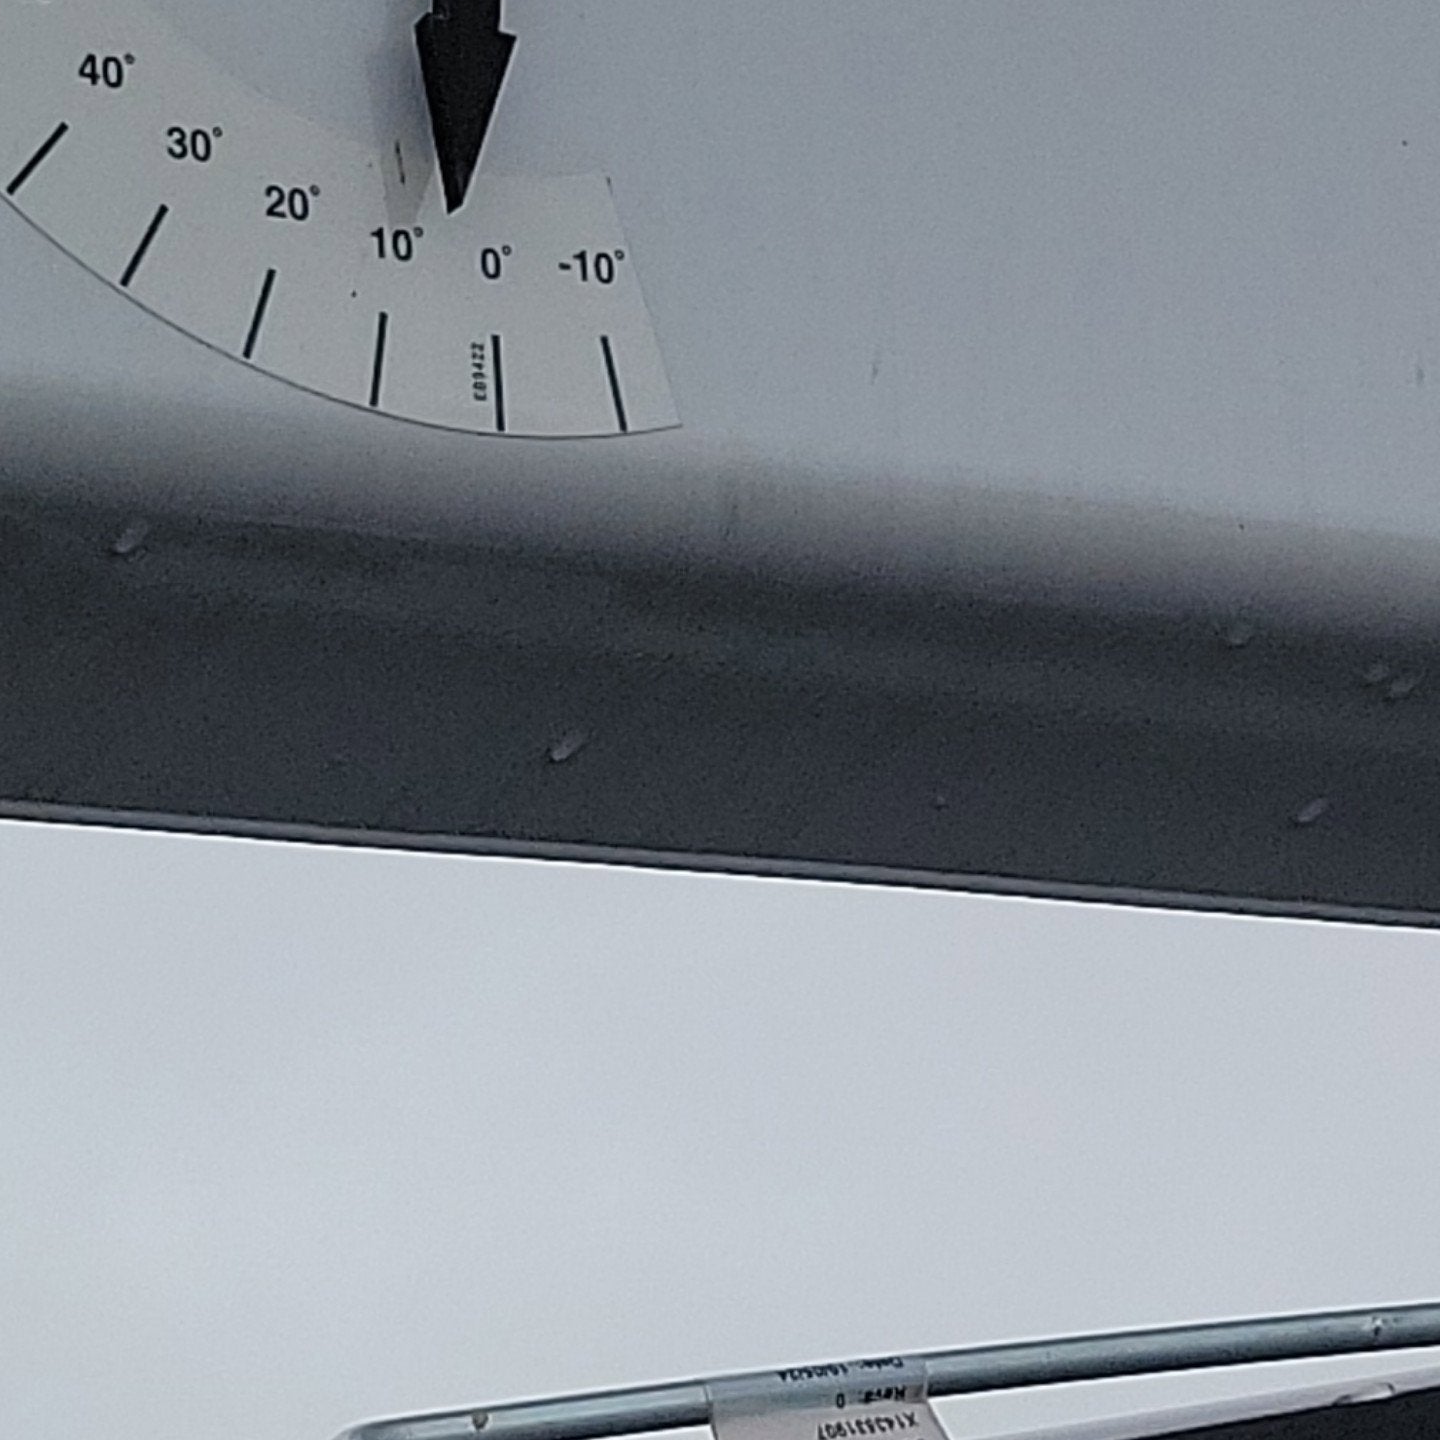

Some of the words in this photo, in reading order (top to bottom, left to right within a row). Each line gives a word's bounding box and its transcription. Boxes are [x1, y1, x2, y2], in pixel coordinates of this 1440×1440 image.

[77, 52, 136, 90] 40°
[166, 126, 223, 163] 30°
[264, 184, 321, 222] 20°
[369, 226, 425, 263] 10°
[480, 244, 512, 280] 0°
[558, 248, 626, 285] -10°
